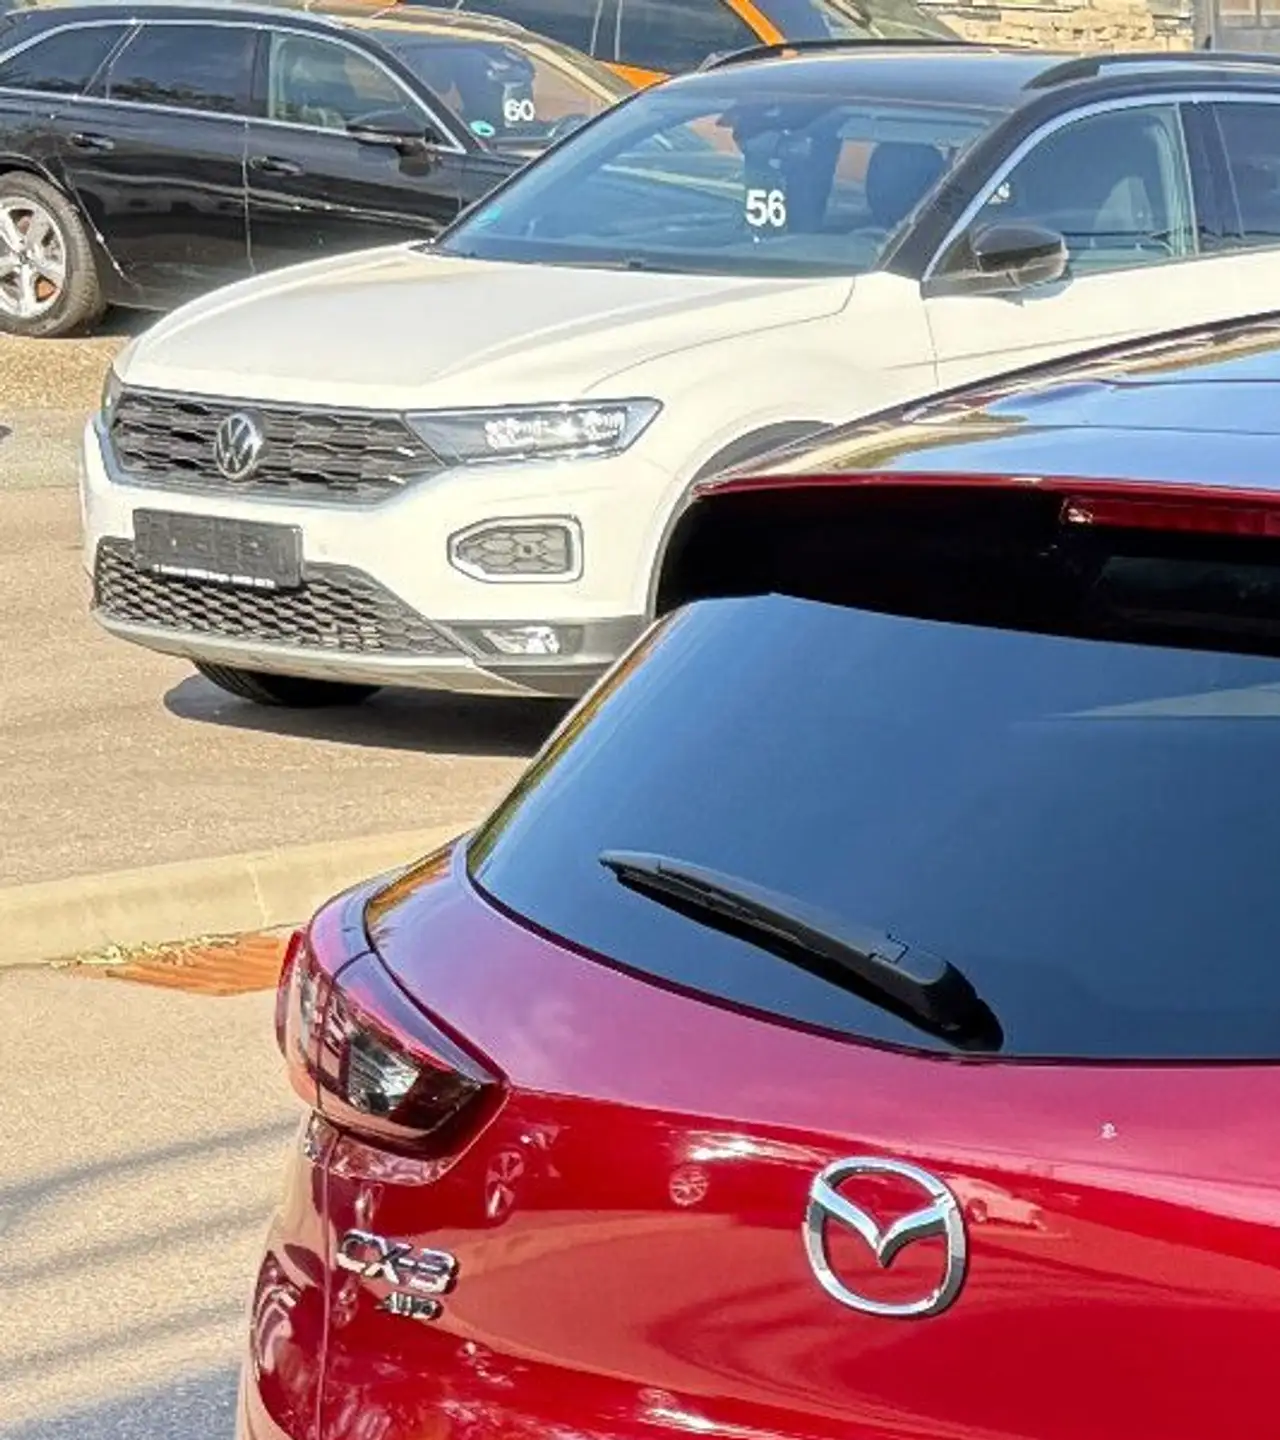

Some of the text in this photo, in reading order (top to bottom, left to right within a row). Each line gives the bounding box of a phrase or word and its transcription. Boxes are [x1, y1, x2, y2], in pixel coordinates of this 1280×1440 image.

[503, 98, 535, 122] 60
[745, 188, 787, 228] 56
[335, 1227, 458, 1294] CX-3
